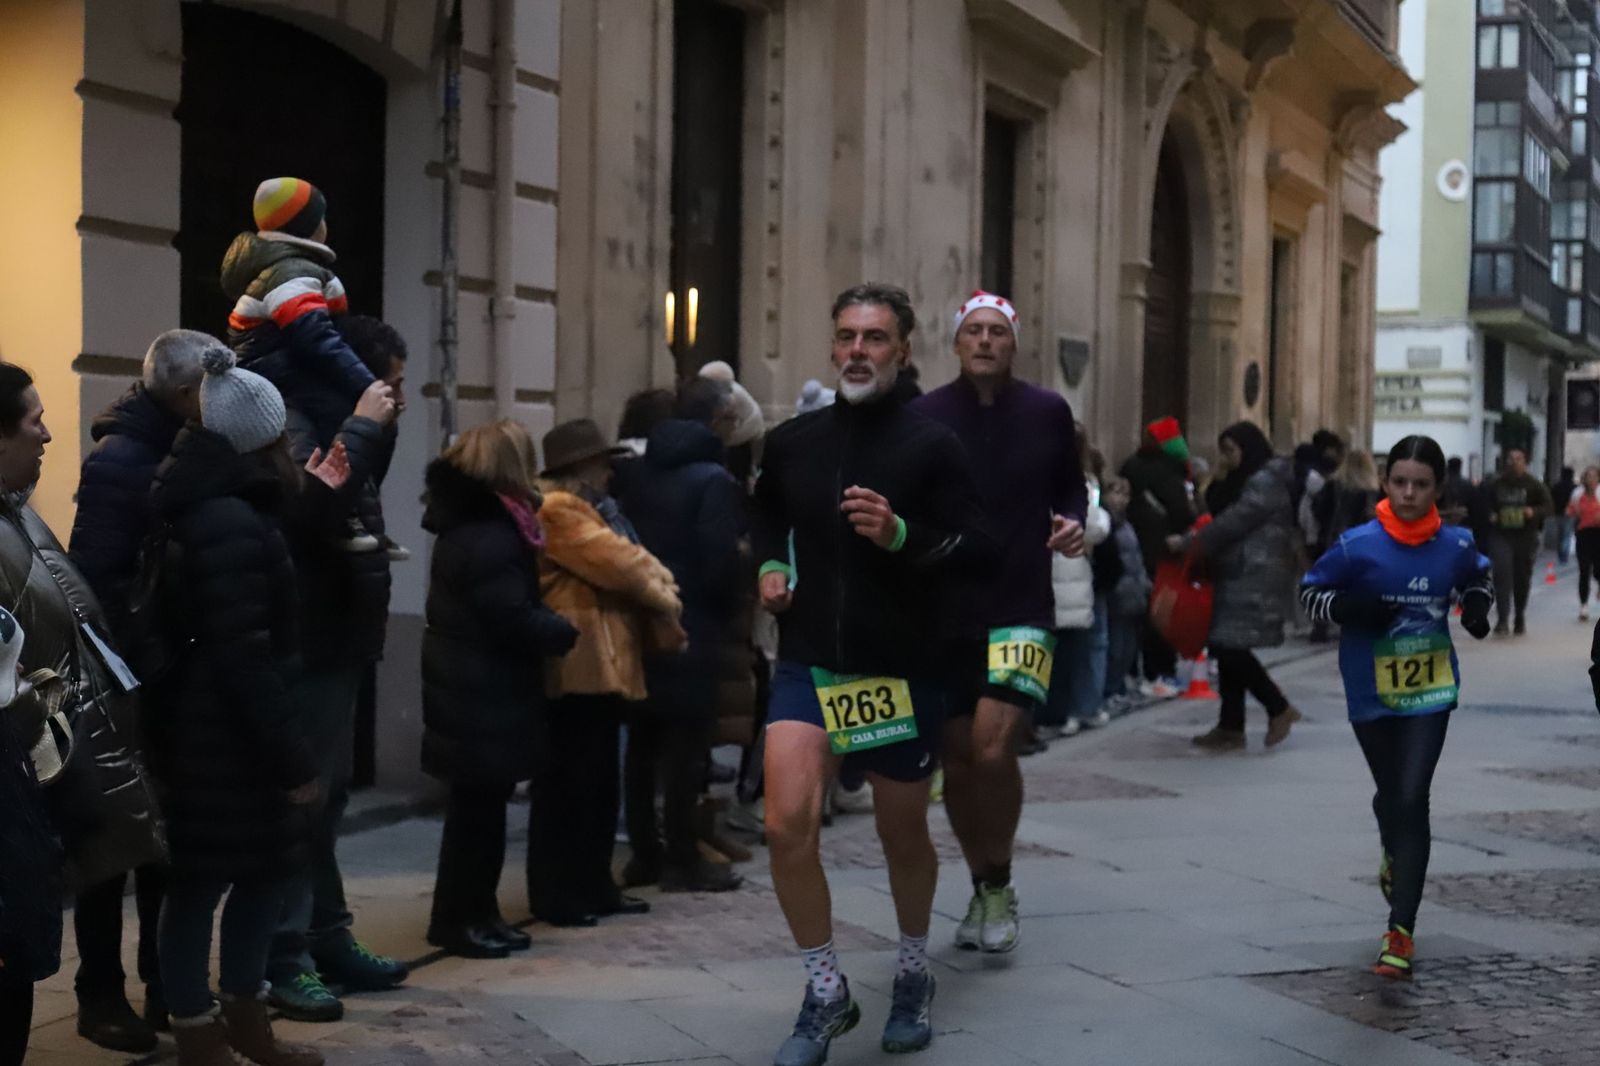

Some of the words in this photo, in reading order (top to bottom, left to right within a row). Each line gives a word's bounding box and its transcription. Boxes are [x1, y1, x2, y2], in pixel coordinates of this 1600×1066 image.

[1408, 576, 1429, 591] 46
[998, 644, 1046, 674] 1107
[1385, 655, 1434, 688] 121
[826, 686, 896, 729] 1263
[876, 724, 911, 739] RURAL
